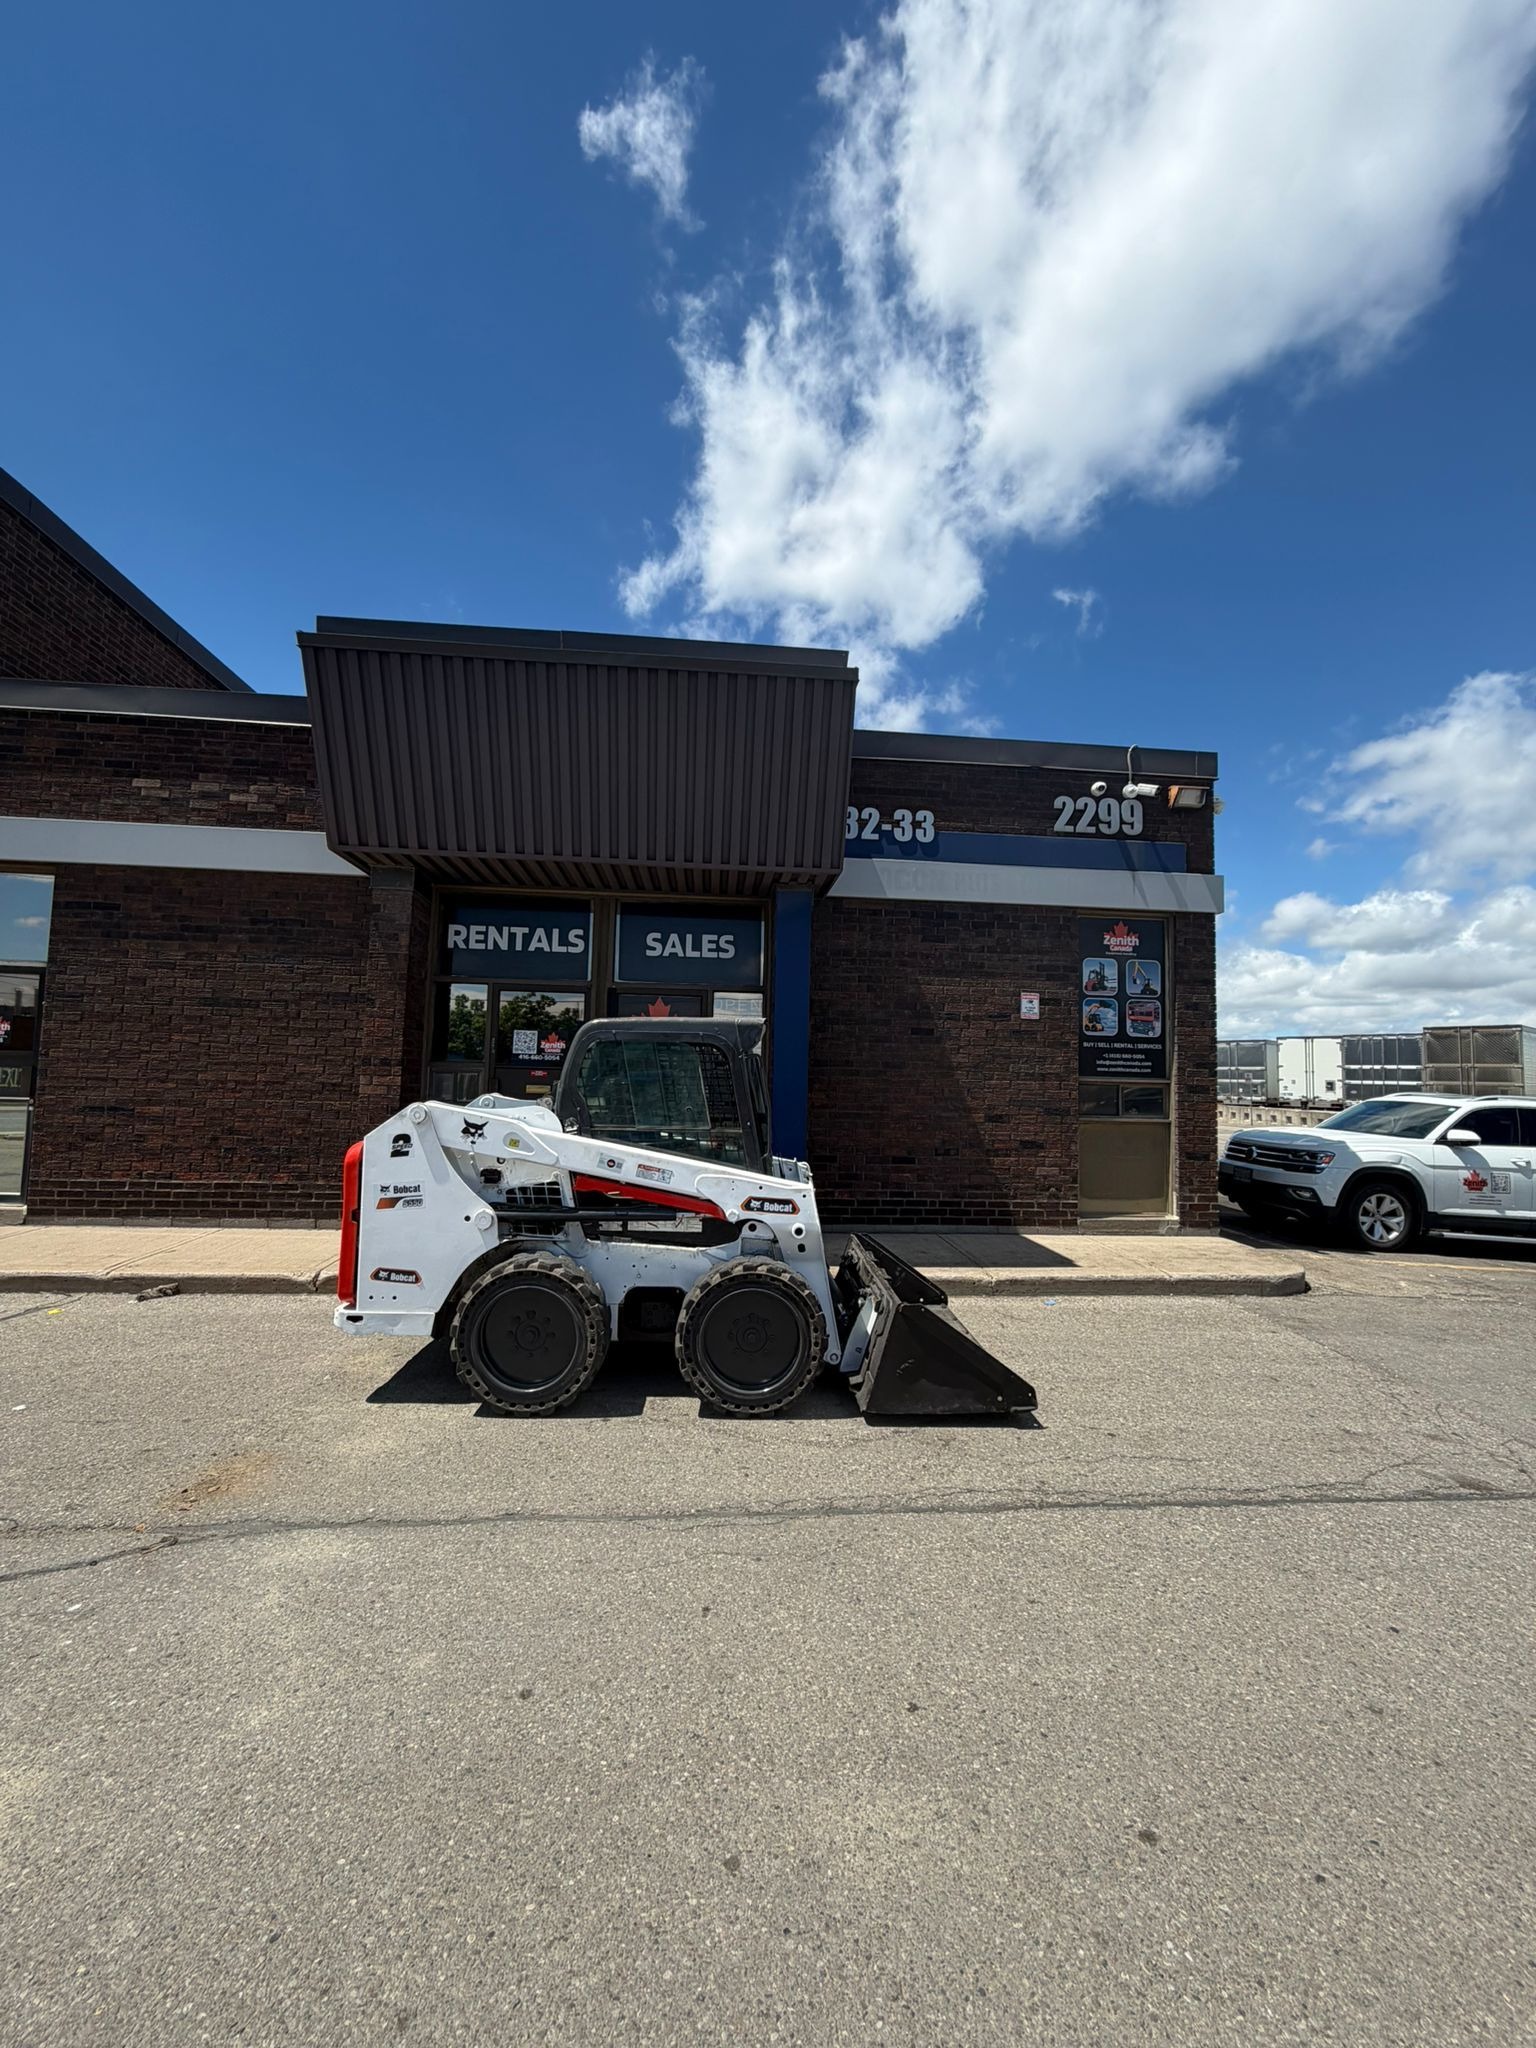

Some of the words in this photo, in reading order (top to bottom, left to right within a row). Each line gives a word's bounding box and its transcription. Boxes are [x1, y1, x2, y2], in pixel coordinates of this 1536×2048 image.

[845, 806, 935, 843] 32-33
[1053, 795, 1144, 836] 2299
[448, 924, 585, 953] RENTALS
[645, 932, 735, 959] SALES
[1103, 935, 1140, 946] Zenith
[540, 1041, 566, 1049] Zenith
[390, 1133, 411, 1158] 2
[393, 1184, 421, 1194] Bobcat
[763, 1201, 793, 1212] Bobcat
[390, 1272, 416, 1283] Bobcat
